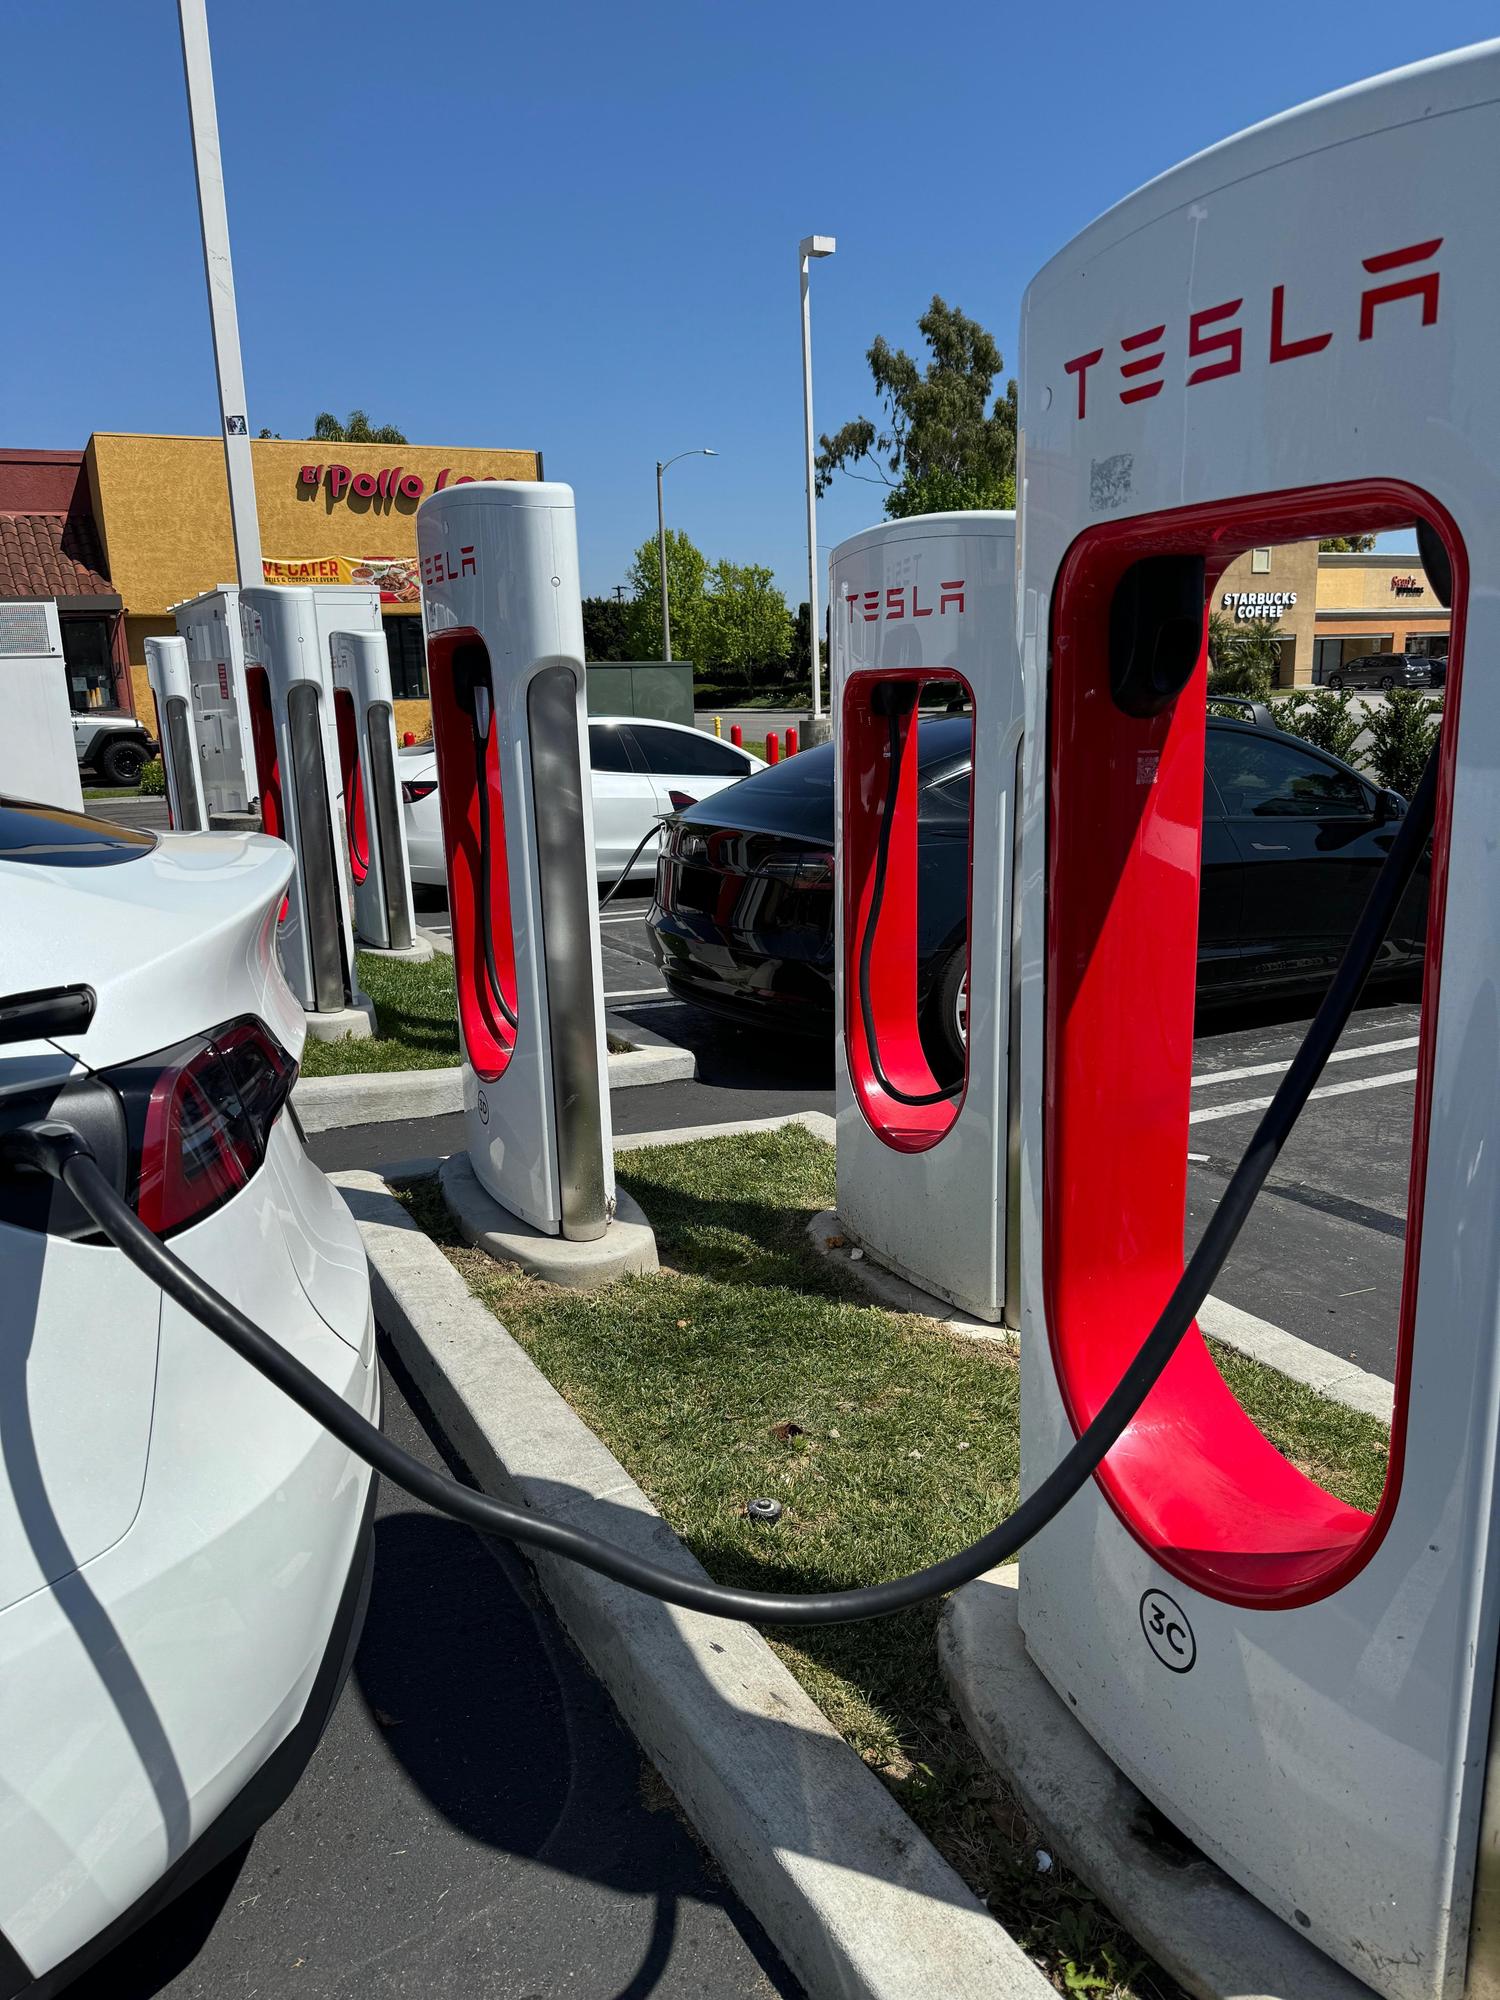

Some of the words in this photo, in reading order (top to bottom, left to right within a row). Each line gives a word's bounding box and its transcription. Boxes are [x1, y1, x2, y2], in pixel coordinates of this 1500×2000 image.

[1064, 238, 1443, 420] TESLA
[301, 464, 324, 484] El
[328, 464, 425, 498] Pollo
[287, 560, 339, 577] CATER
[420, 545, 476, 586] ESLA
[845, 580, 965, 624] TESLA
[1224, 592, 1297, 606] STARBUCKS
[1237, 605, 1284, 619] COFFEE
[1149, 1602, 1187, 1655] 3C
